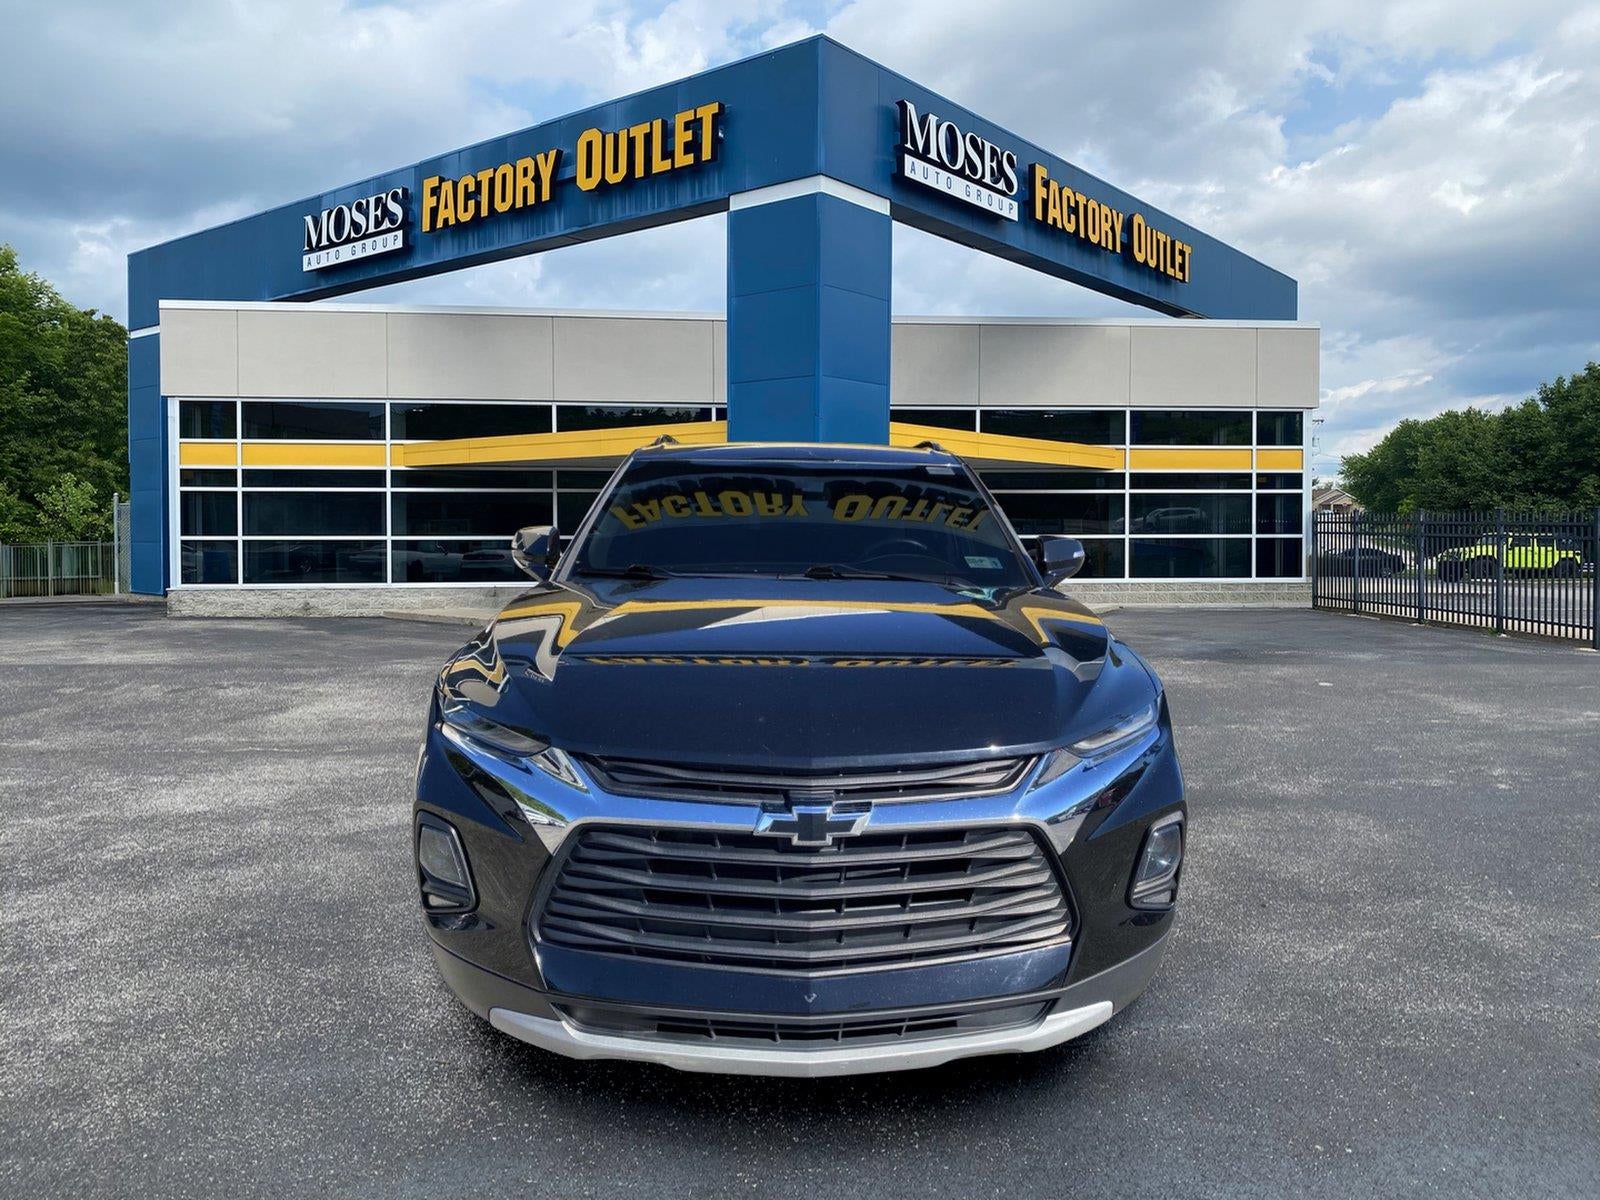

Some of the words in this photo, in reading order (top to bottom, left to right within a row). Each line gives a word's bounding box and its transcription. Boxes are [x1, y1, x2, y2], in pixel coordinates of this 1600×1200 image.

[421, 148, 559, 233] FACTORY
[575, 102, 721, 192] OUTLET
[903, 99, 1019, 196] MOSES
[302, 187, 404, 251] MOSES
[909, 161, 953, 190] AUTO
[964, 184, 1015, 215] GROUP
[1032, 163, 1124, 253] FACTORY
[1130, 212, 1193, 283] OUTLET
[306, 251, 341, 268] AUTO
[350, 234, 401, 256] GROUP
